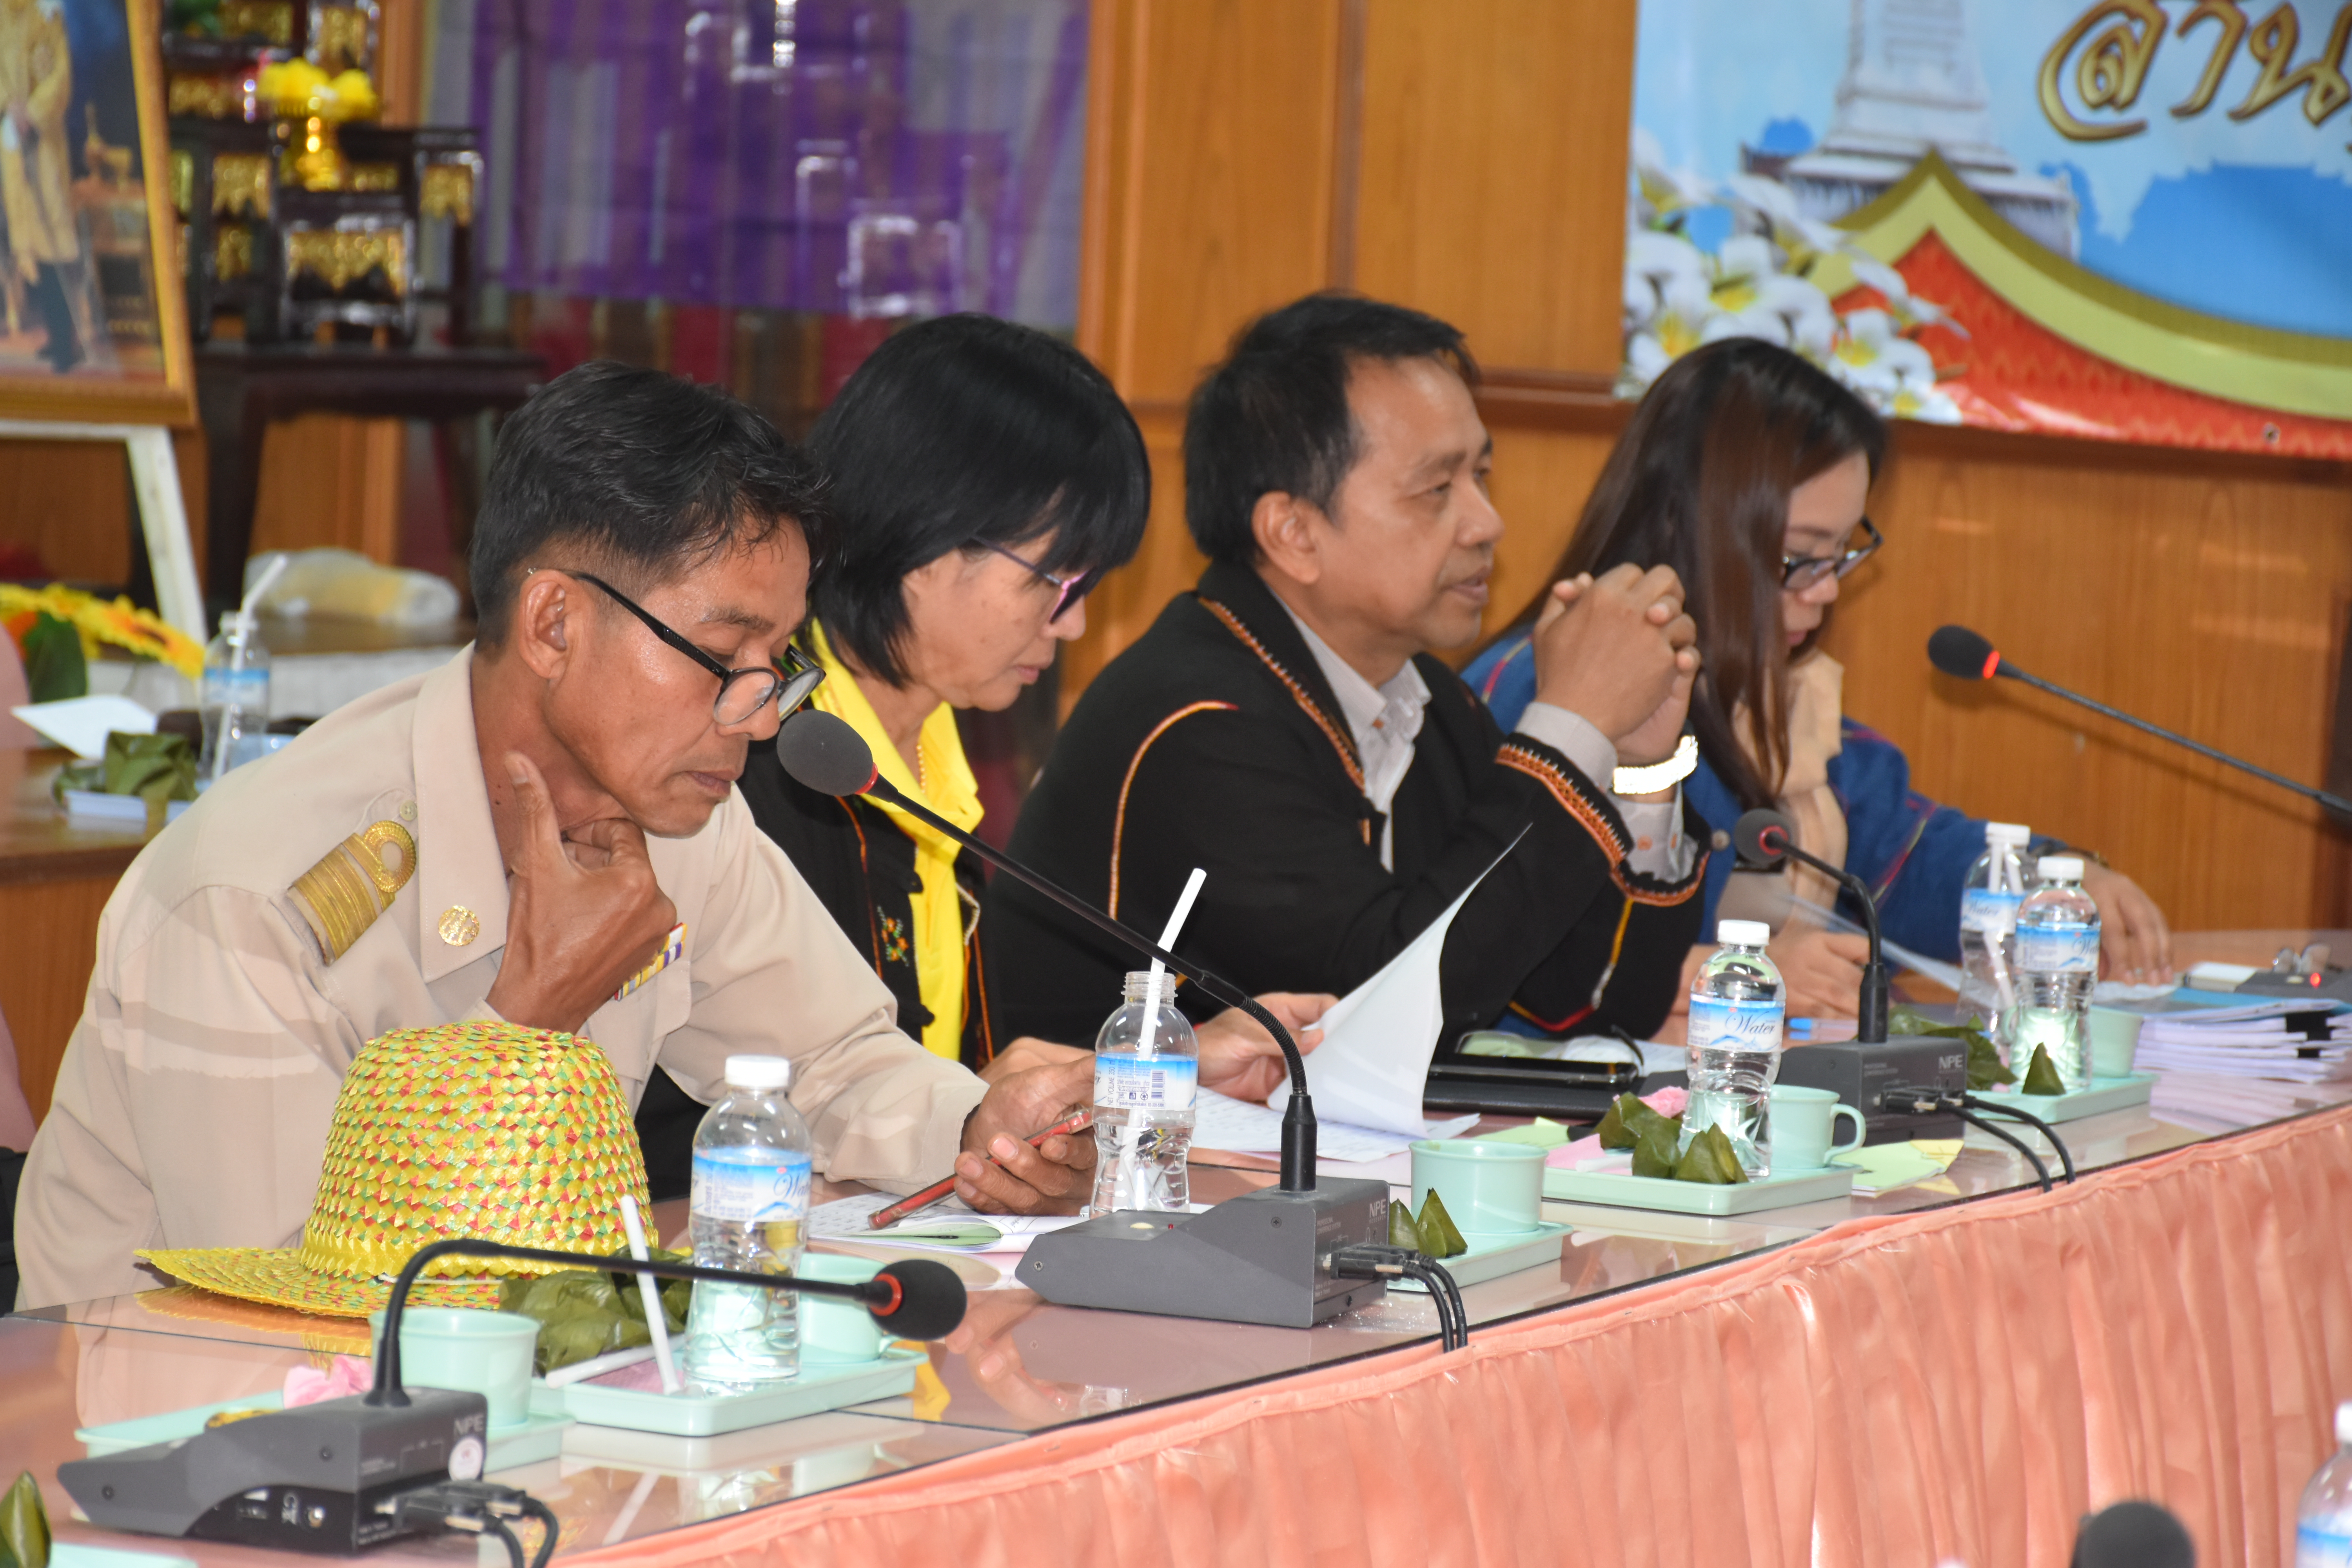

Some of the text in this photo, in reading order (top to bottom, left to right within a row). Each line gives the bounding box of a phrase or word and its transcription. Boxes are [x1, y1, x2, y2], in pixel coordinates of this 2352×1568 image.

[1726, 1011, 1775, 1034] Water
[1939, 1054, 1963, 1069] NPE
[1369, 1199, 1386, 1218] NPE
